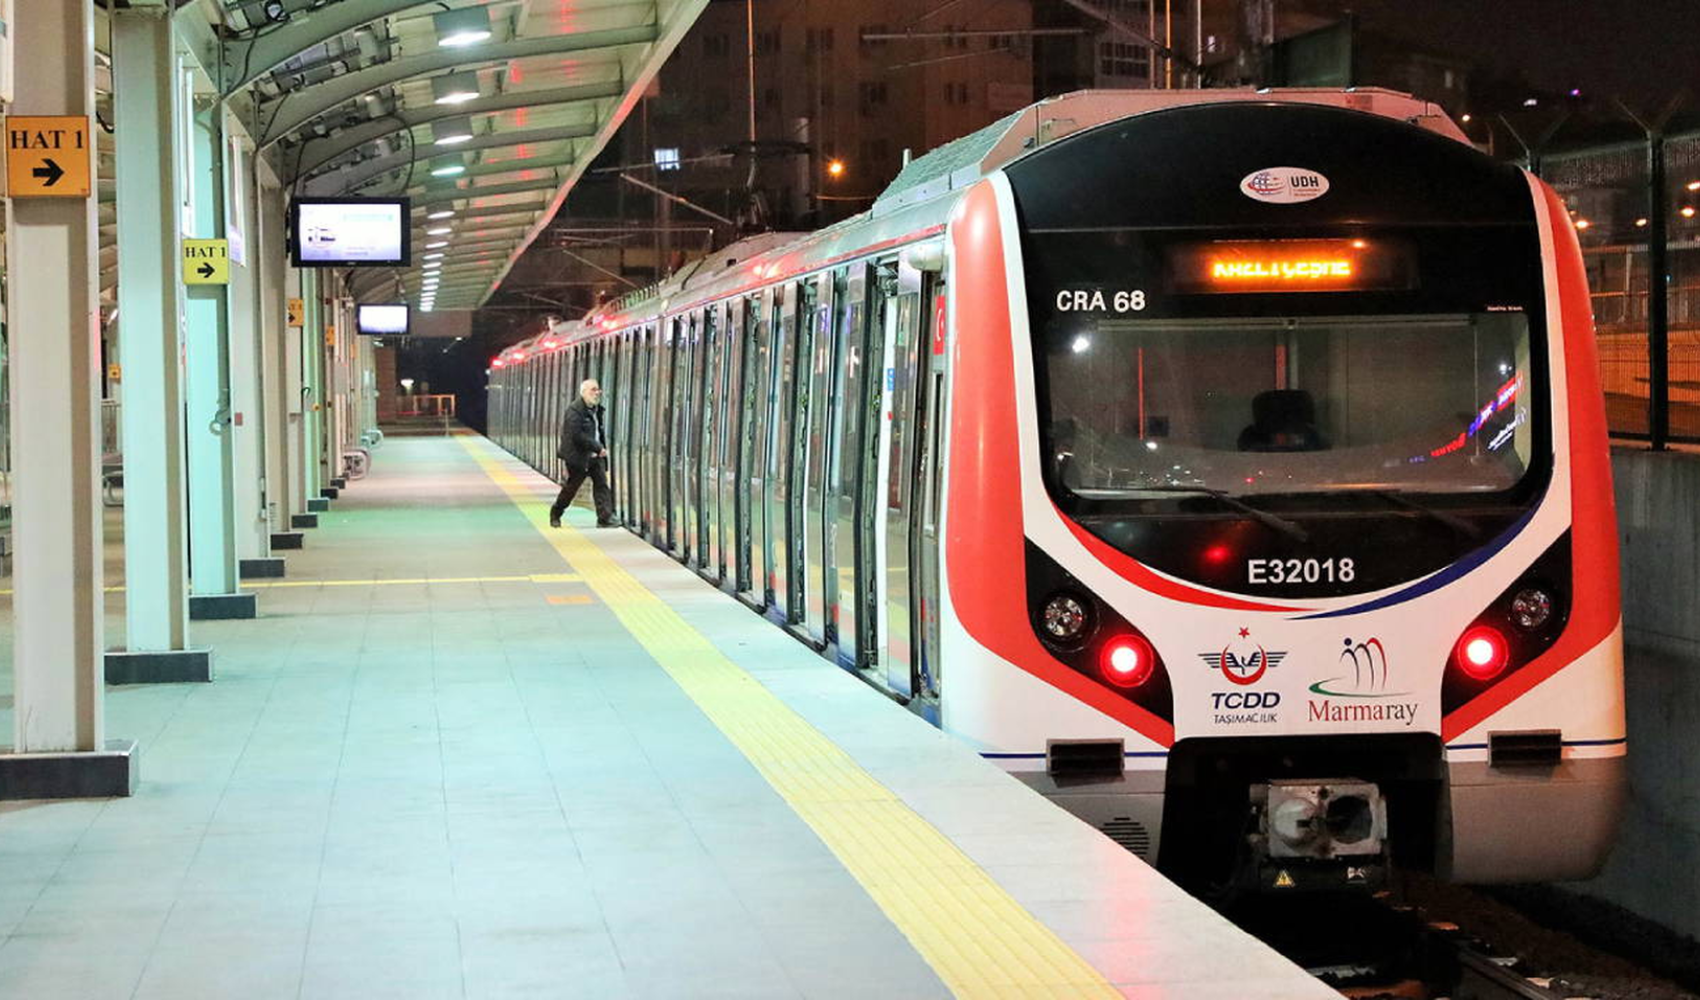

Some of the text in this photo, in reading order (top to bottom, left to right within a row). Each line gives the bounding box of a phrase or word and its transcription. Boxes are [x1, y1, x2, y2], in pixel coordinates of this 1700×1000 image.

[11, 129, 84, 149] HAT 1
[1290, 175, 1319, 188] UDH
[185, 246, 226, 258] HAT 1
[1056, 289, 1146, 313] CRA 68
[1248, 557, 1355, 584] E32018
[1210, 691, 1281, 709] TCDD
[1308, 699, 1418, 726] Marmaray
